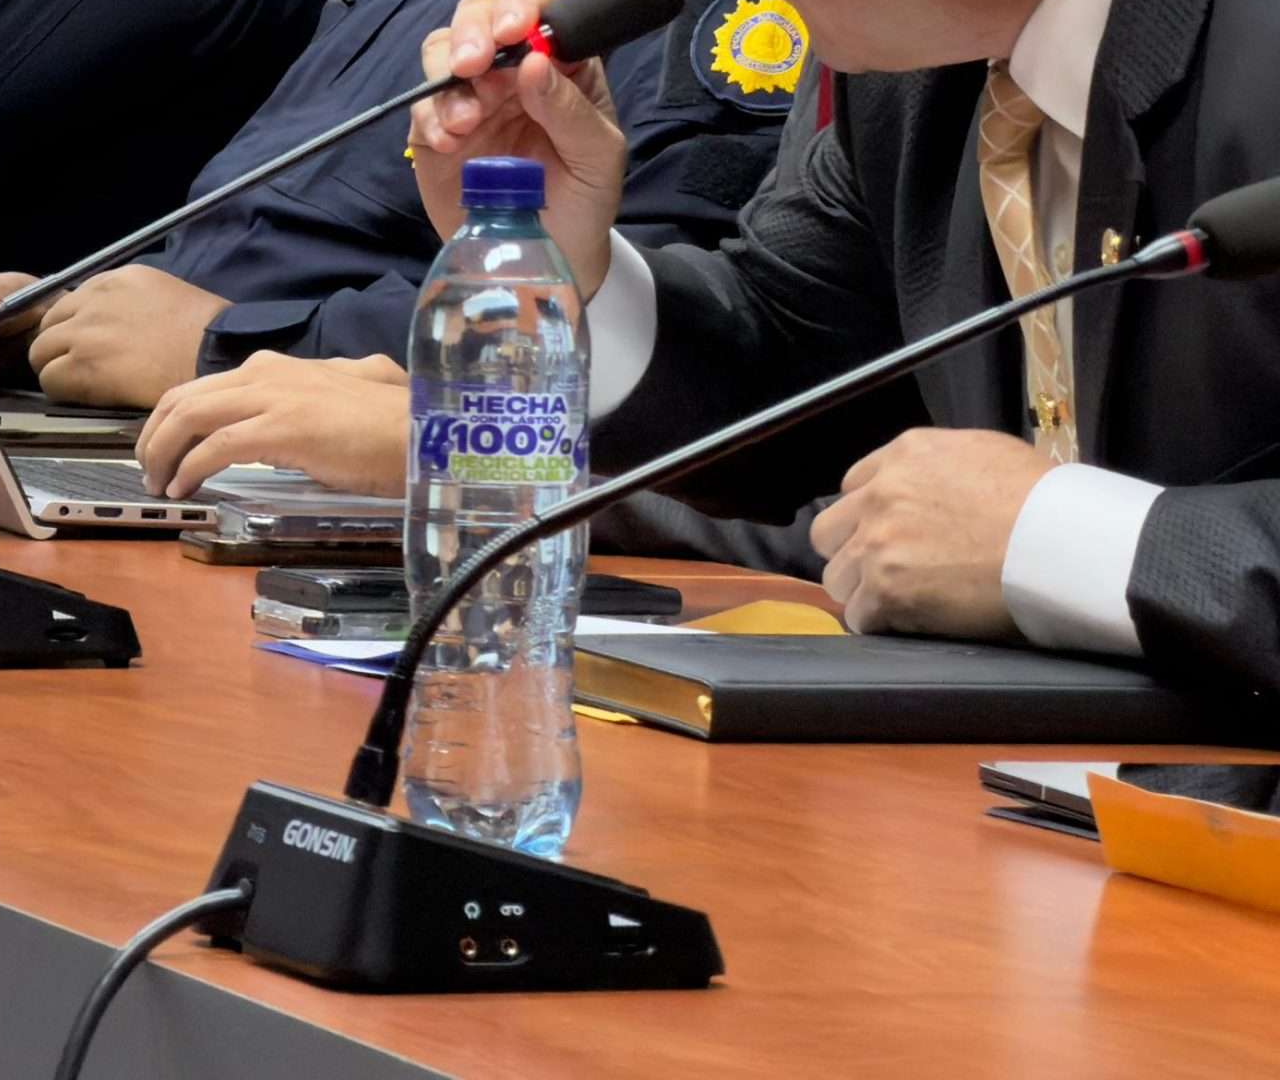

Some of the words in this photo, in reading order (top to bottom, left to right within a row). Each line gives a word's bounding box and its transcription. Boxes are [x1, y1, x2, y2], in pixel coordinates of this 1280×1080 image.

[462, 395, 567, 415] HECHA
[451, 424, 573, 456] 100%
[283, 819, 358, 863] GONSIN
